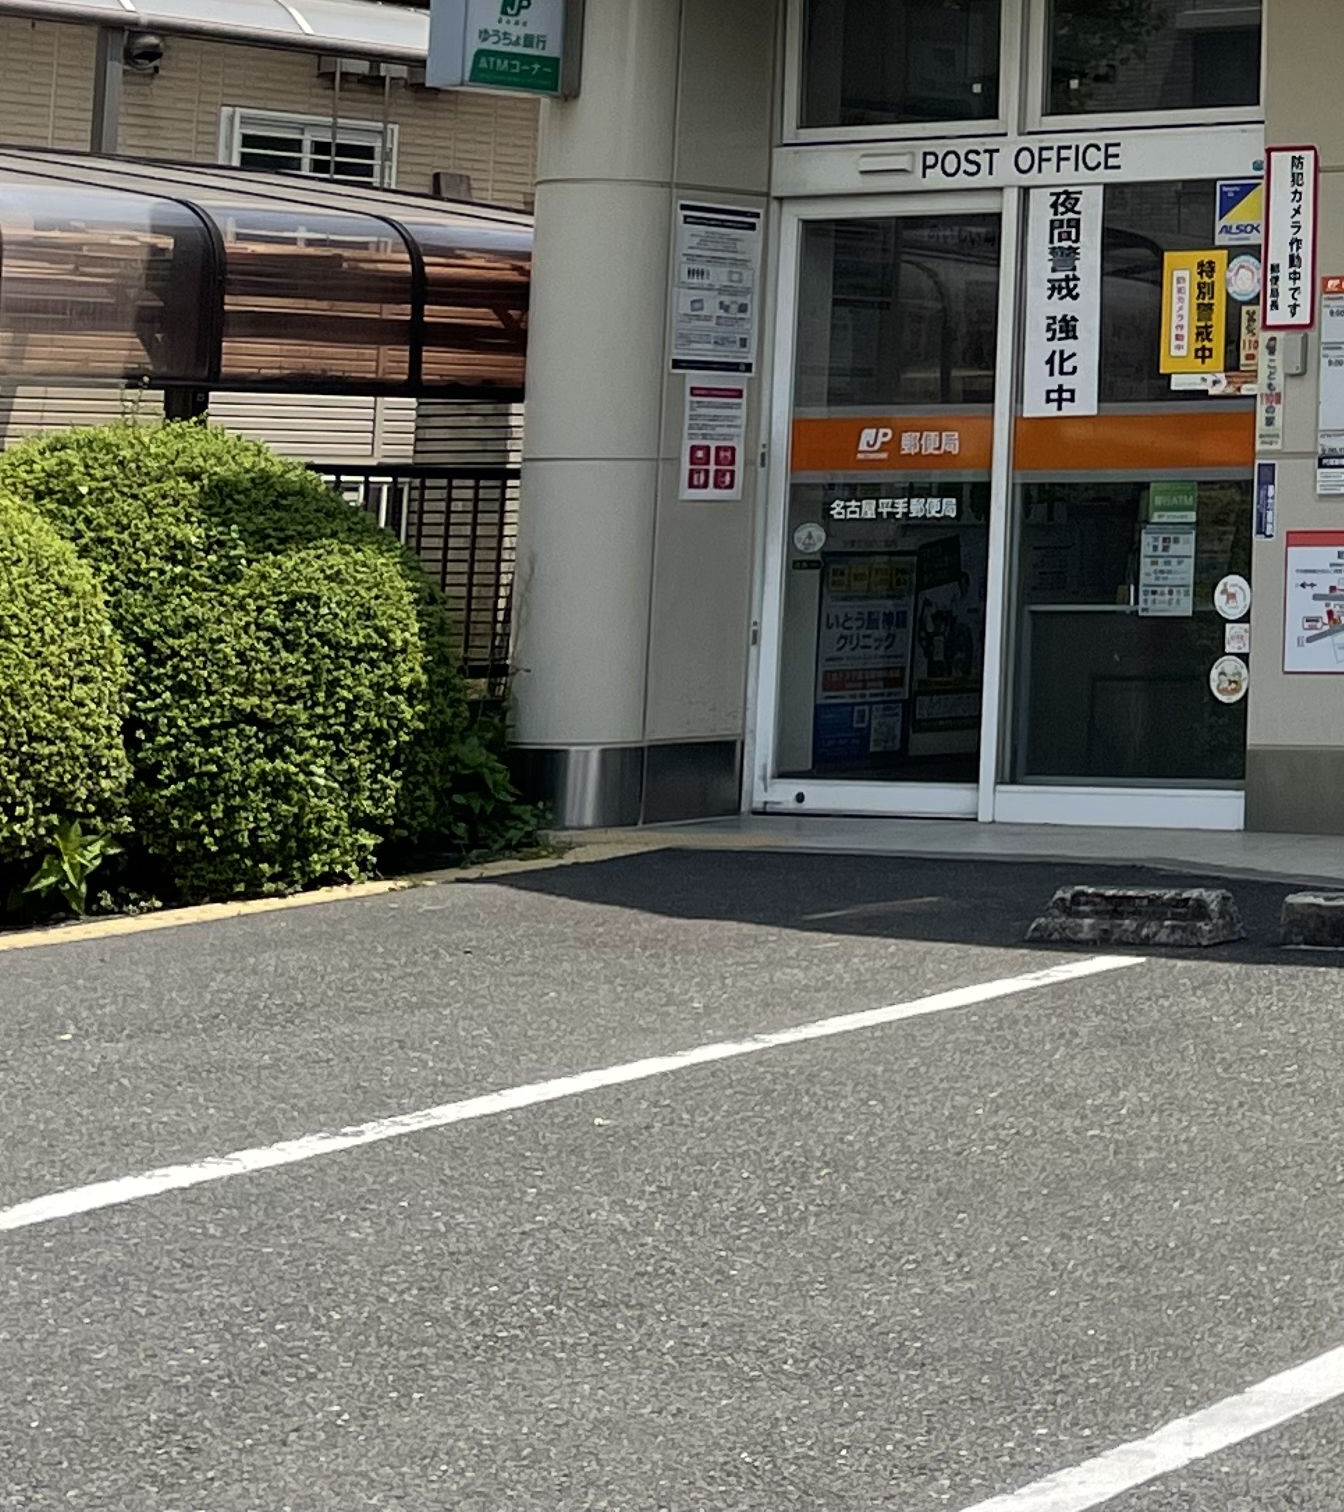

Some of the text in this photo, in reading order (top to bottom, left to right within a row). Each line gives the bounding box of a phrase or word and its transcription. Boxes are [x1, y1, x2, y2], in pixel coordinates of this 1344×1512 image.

[478, 28, 548, 51] ゆうちょ銀行
[479, 56, 553, 75] ATMコーナー
[921, 142, 1122, 178] POST OFFICE
[1288, 155, 1305, 319] 防犯カメラ作動中です
[1194, 259, 1216, 365] 特別警戒中
[901, 431, 960, 455] 郵便局
[829, 497, 957, 520] 名古屋平手郵便局
[836, 632, 897, 653] クリニック
